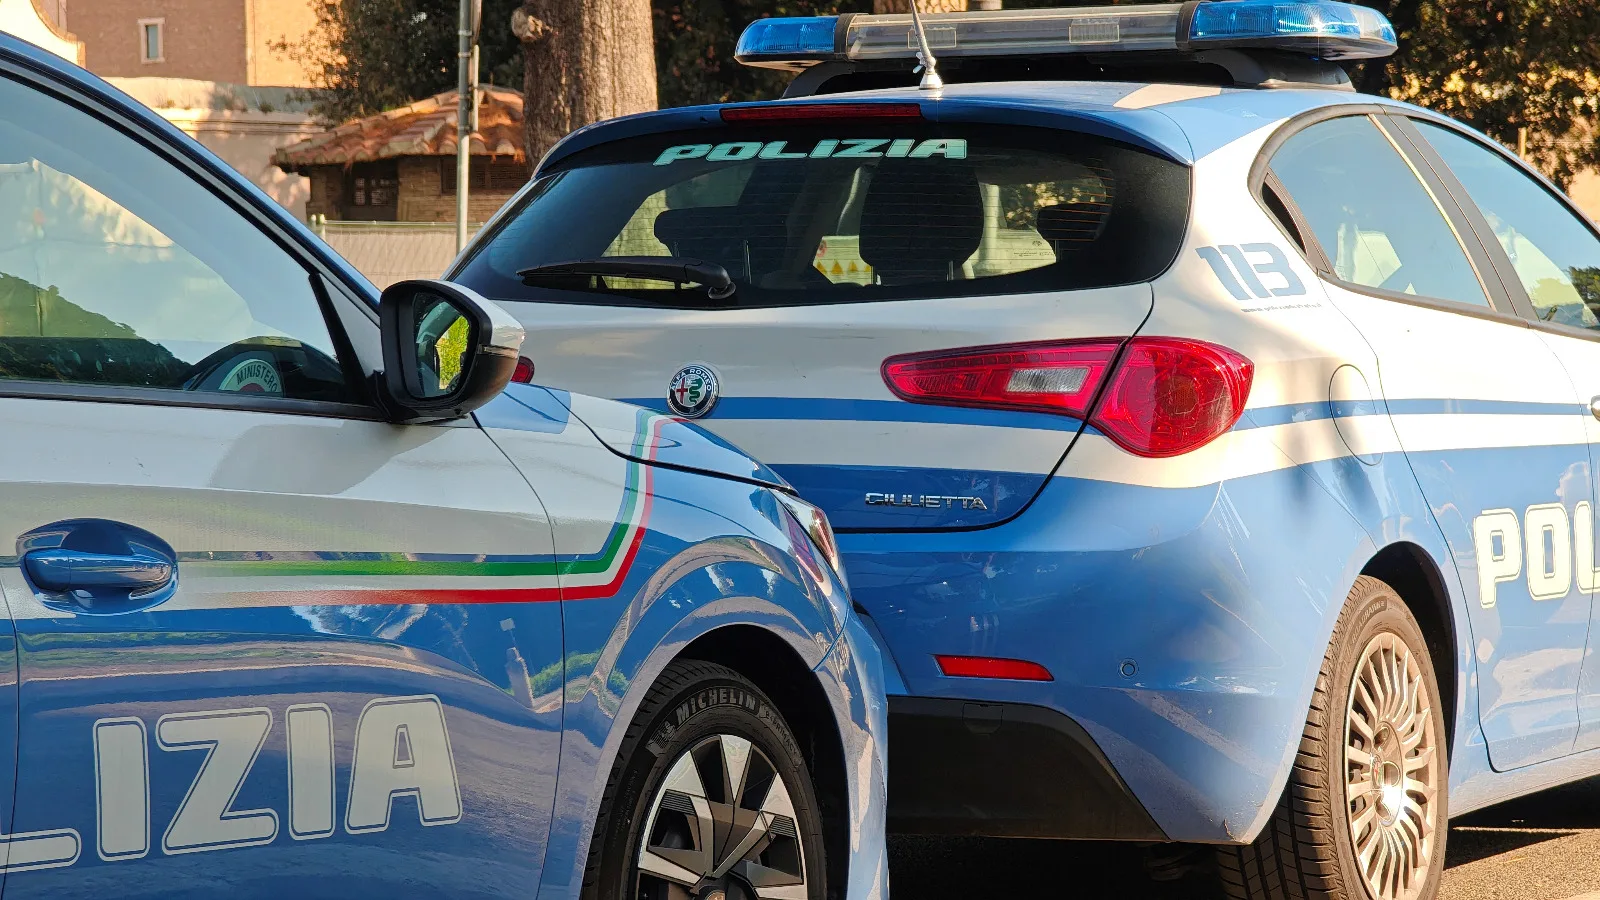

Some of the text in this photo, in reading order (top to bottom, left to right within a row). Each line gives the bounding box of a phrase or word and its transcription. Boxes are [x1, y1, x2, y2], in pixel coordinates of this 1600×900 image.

[653, 138, 967, 166] POLIZIA
[1195, 243, 1306, 300] 113
[236, 364, 278, 392] MINISTERO
[689, 368, 712, 391] ROMEO
[865, 492, 988, 510] GIULIETTA
[675, 688, 756, 725] MICHELIN
